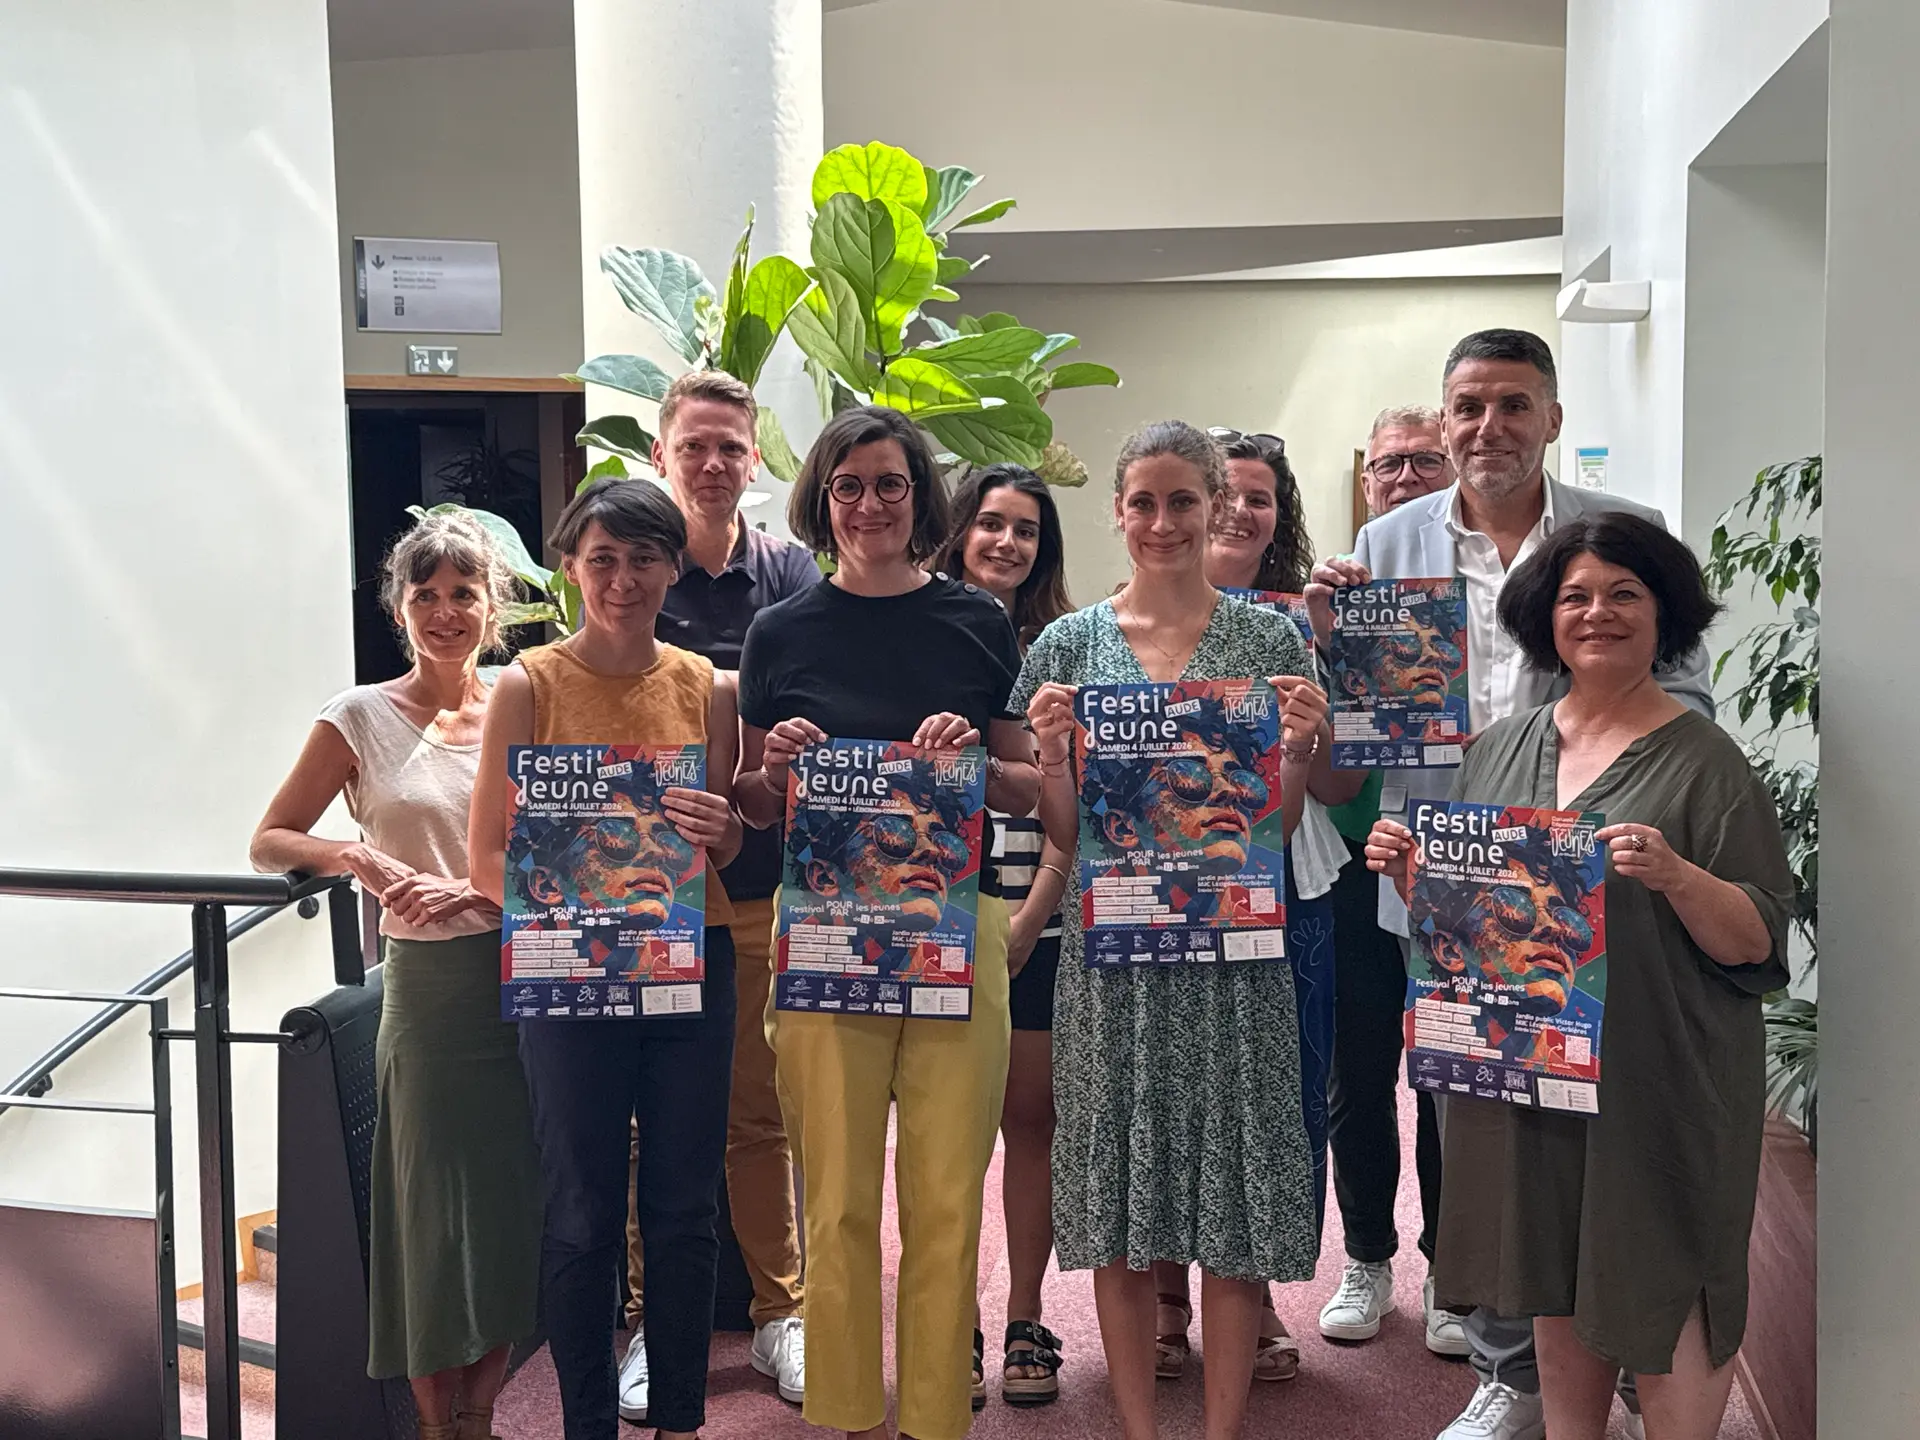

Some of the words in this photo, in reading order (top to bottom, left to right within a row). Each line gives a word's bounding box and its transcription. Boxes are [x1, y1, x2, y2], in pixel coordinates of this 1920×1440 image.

[1402, 594, 1425, 606] AUDE
[1333, 605, 1411, 629] Jeune
[1084, 688, 1169, 716] Festi'
[1167, 702, 1198, 716] AUDE
[1083, 716, 1177, 748] Jeune
[1096, 744, 1129, 753] SAMEDI
[1131, 743, 1137, 751] 4
[1138, 741, 1169, 751] JUILLET
[1171, 741, 1191, 749] 2026
[516, 749, 602, 774] Festi'
[599, 765, 630, 777] AUDE
[879, 763, 910, 773] AUDE
[796, 766, 888, 798] Jeune
[515, 775, 608, 805] Jeune
[527, 802, 560, 810] SAMEDI
[569, 802, 599, 810] JUILLET
[807, 795, 840, 804] SAMEDI
[848, 797, 879, 806] JUILLET
[880, 798, 900, 806] 2026
[1416, 805, 1497, 836] Festi'
[1494, 830, 1525, 840] AUDE
[1127, 849, 1154, 859] POUR
[1414, 832, 1503, 865] Jeune
[1090, 857, 1125, 867] Festival
[1172, 849, 1203, 859] jeunes
[1131, 858, 1151, 866] PAR
[1426, 862, 1457, 872] SAMEDI
[1466, 865, 1495, 876] JUILLET
[1497, 868, 1517, 877] 2026
[511, 912, 547, 921] Festival
[595, 906, 626, 915] jeunes
[549, 906, 577, 914] POUR
[870, 904, 900, 912] jeunes
[1416, 979, 1449, 988] Festival
[1480, 981, 1493, 990] les
[1495, 982, 1525, 991] jeunes
[1451, 976, 1478, 986] POUR
[1455, 985, 1473, 993] PAR
